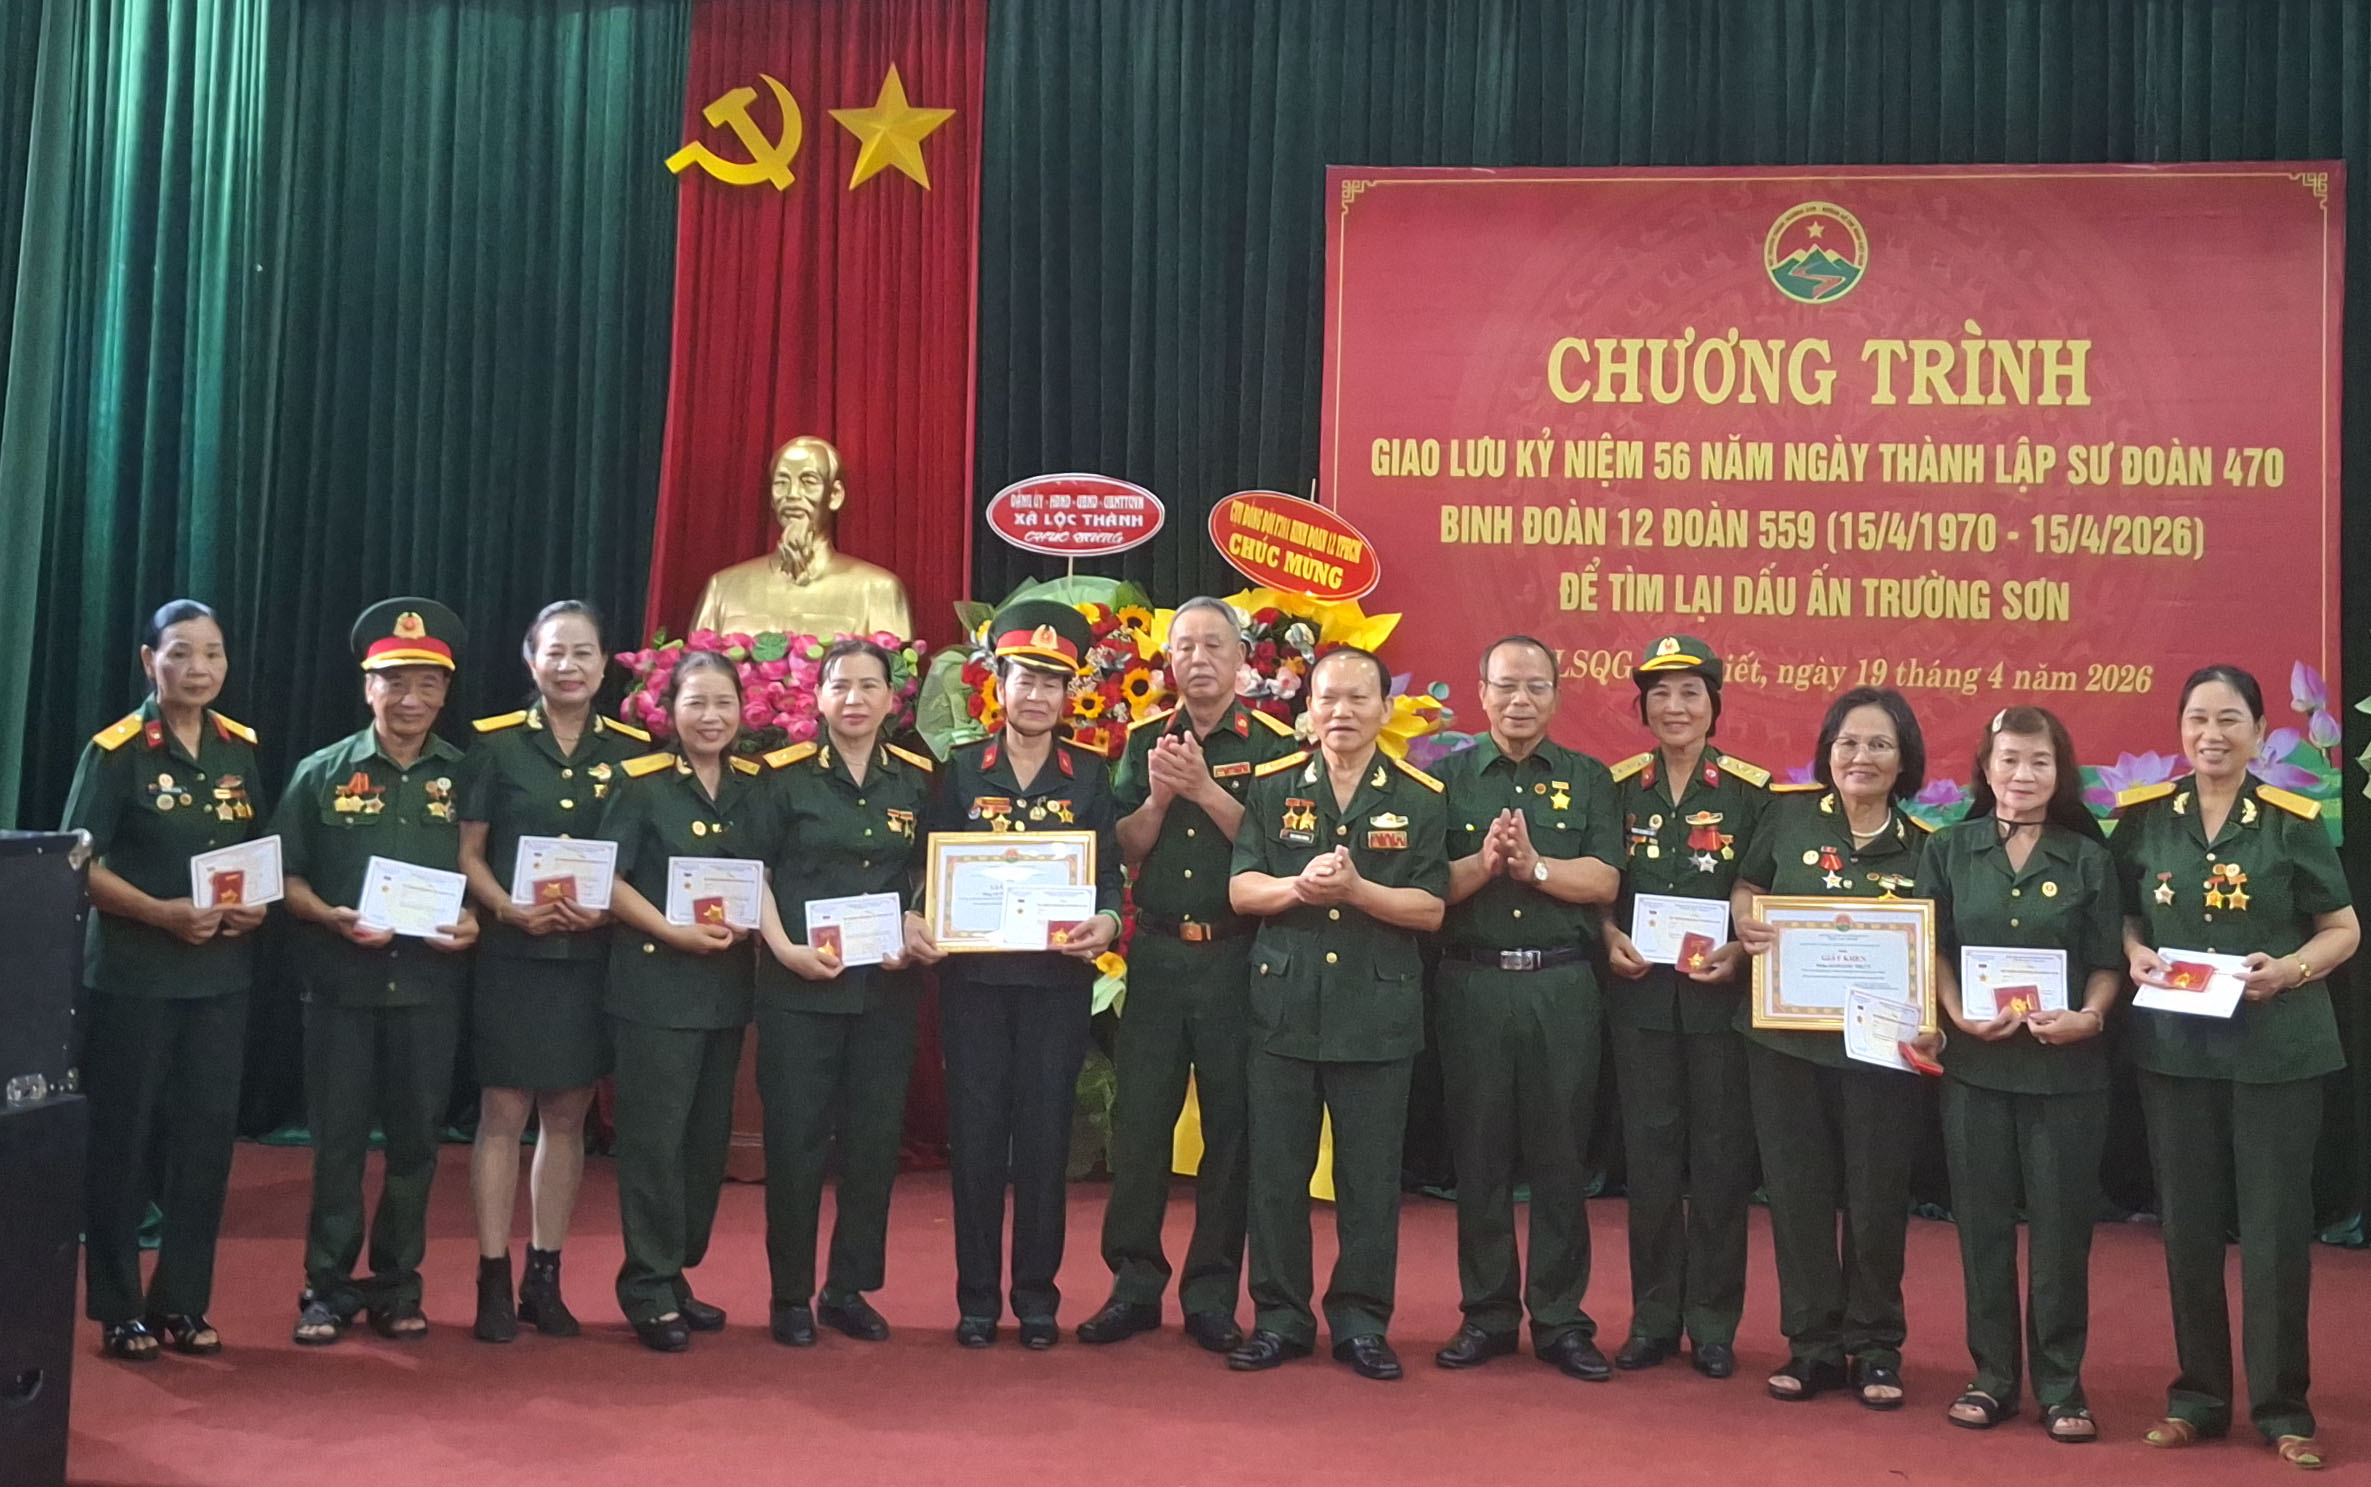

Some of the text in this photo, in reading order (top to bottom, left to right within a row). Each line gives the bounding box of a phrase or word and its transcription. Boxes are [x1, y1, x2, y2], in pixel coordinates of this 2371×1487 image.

[1547, 319, 2093, 407] CHƯƠNG TRÌNH
[1370, 427, 2285, 493] GIAO LƯU KỶ NIỆM 56 NĂM NGÀY THÀNH LẬP SƯ ĐOÀN 470
[1014, 510, 1144, 530] XÃ LỘC THÀNH
[1440, 504, 1513, 545] BINH
[1521, 498, 1607, 546] ĐOÀN
[1617, 507, 1654, 546] 12
[1662, 501, 1749, 548] ĐOÀN
[1758, 510, 1816, 550] 559
[1827, 511, 1997, 555] (15/4/1970
[2031, 513, 2204, 561] 15/4/2026)
[1229, 533, 1345, 590] CHÚC MỪNG
[1558, 556, 2070, 623] ĐỂ TÌM LẠI DẤU ẤN TRƯỜNG SƠN
[1553, 649, 2154, 695] LSQG iết, ngày 19 tháng 4 năm 2026
